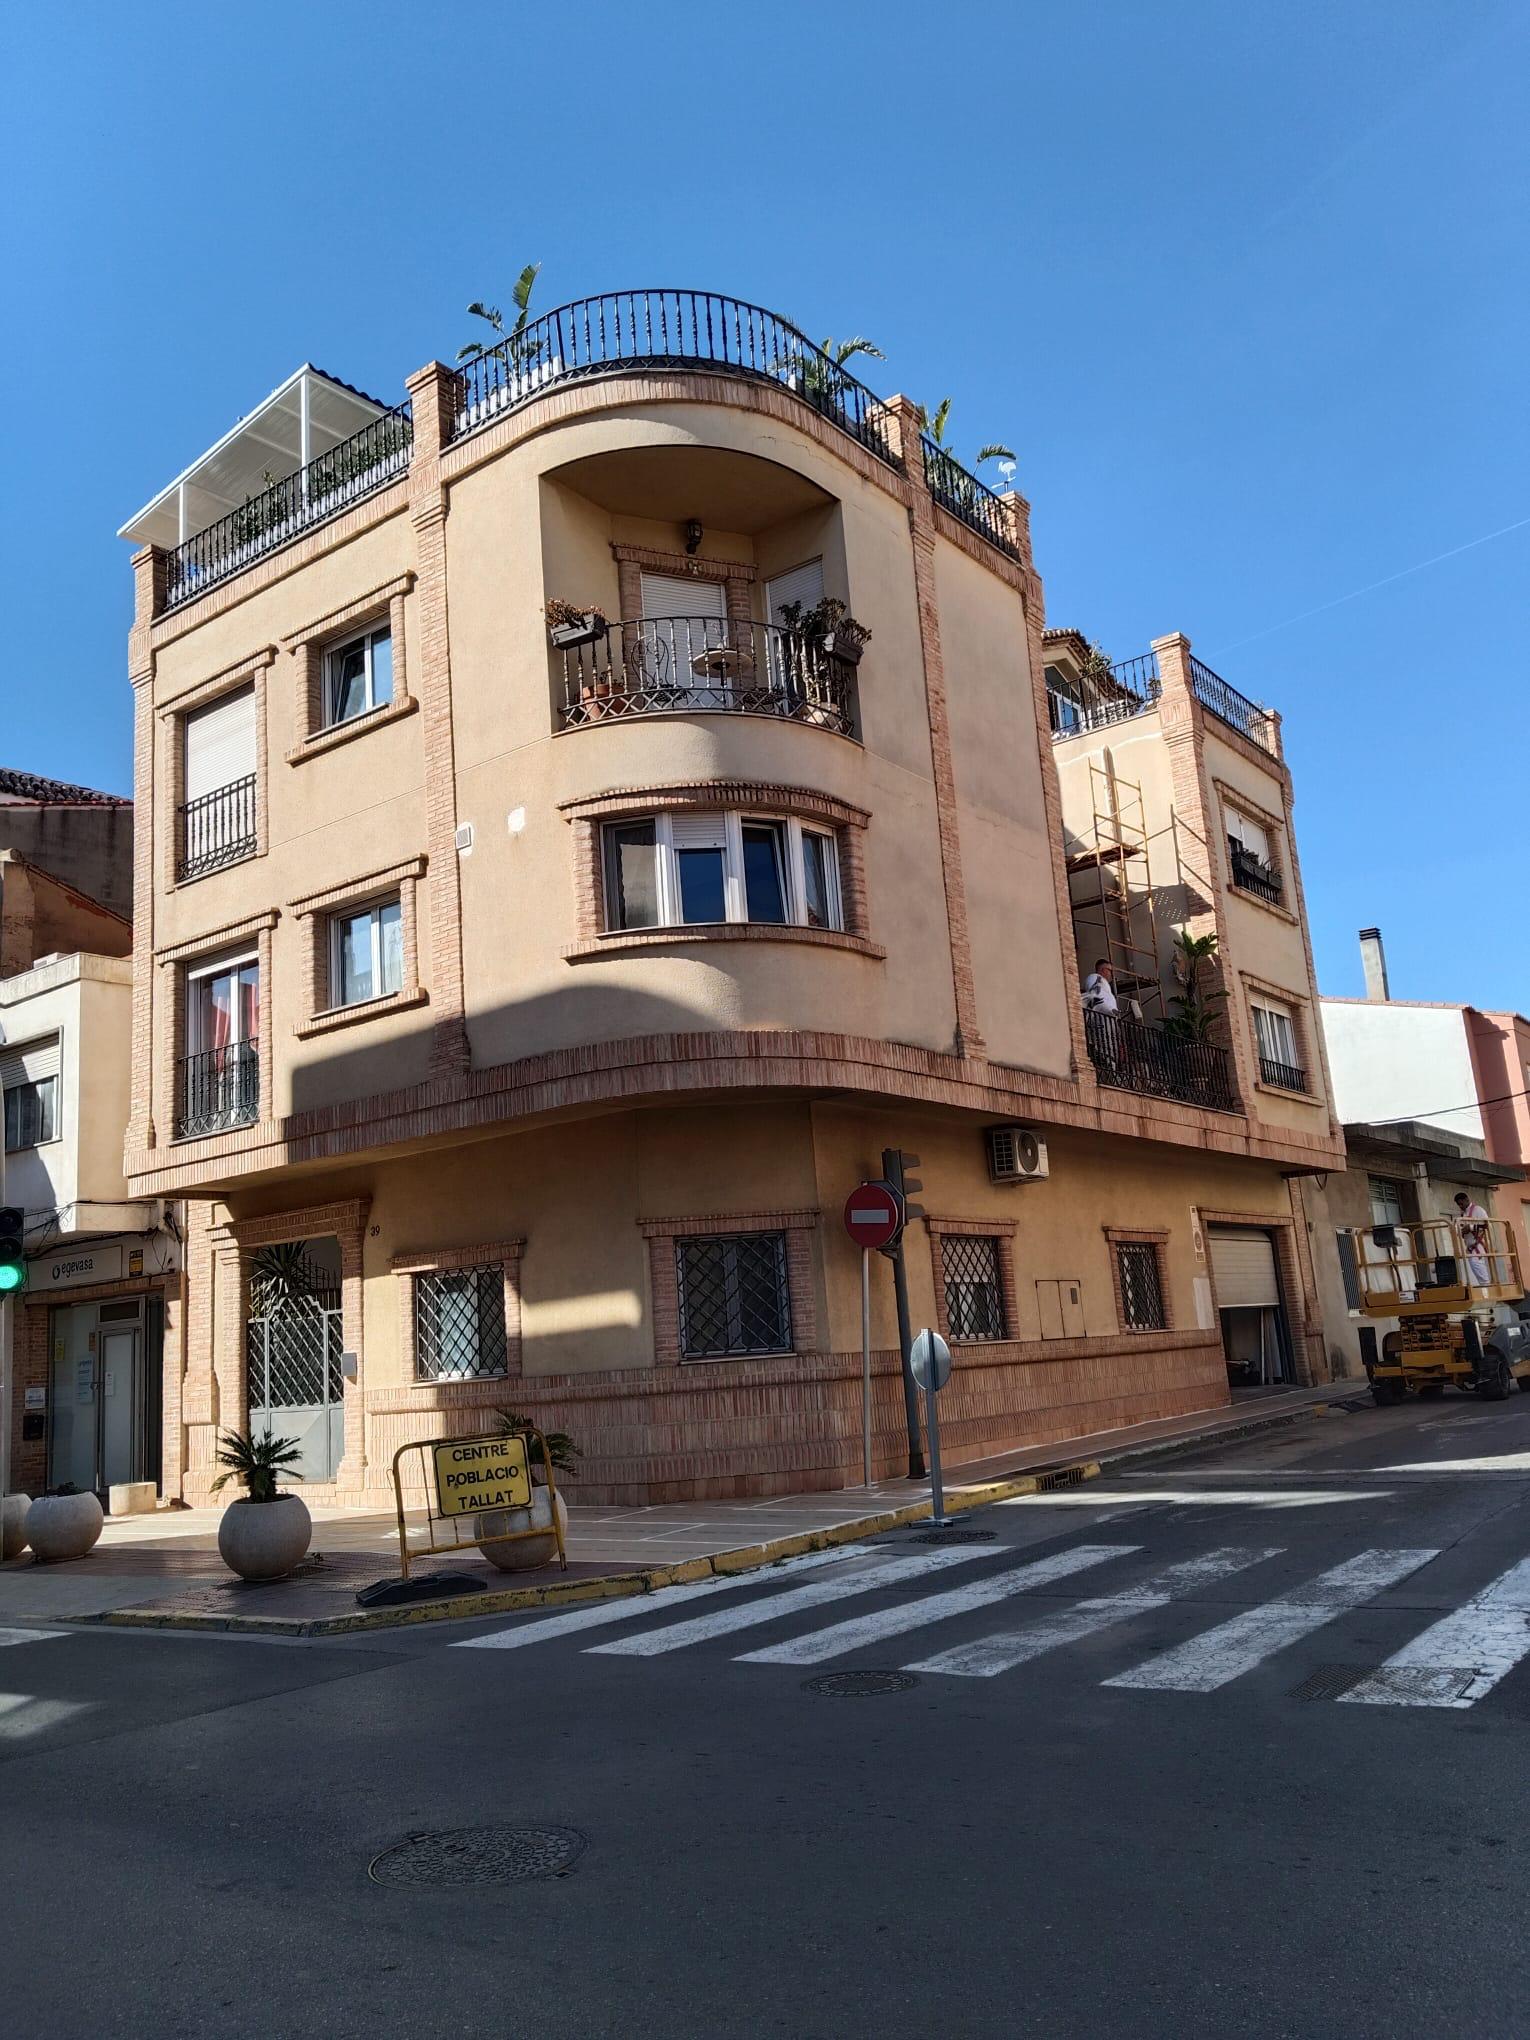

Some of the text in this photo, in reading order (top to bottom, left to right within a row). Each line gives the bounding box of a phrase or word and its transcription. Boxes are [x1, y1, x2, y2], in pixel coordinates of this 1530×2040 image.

[370, 1225, 381, 1237] 39
[61, 1258, 94, 1278] egevasa
[452, 1443, 509, 1462] CENTRE
[446, 1465, 519, 1487] POBLACIO
[457, 1490, 514, 1509] TALLAT
